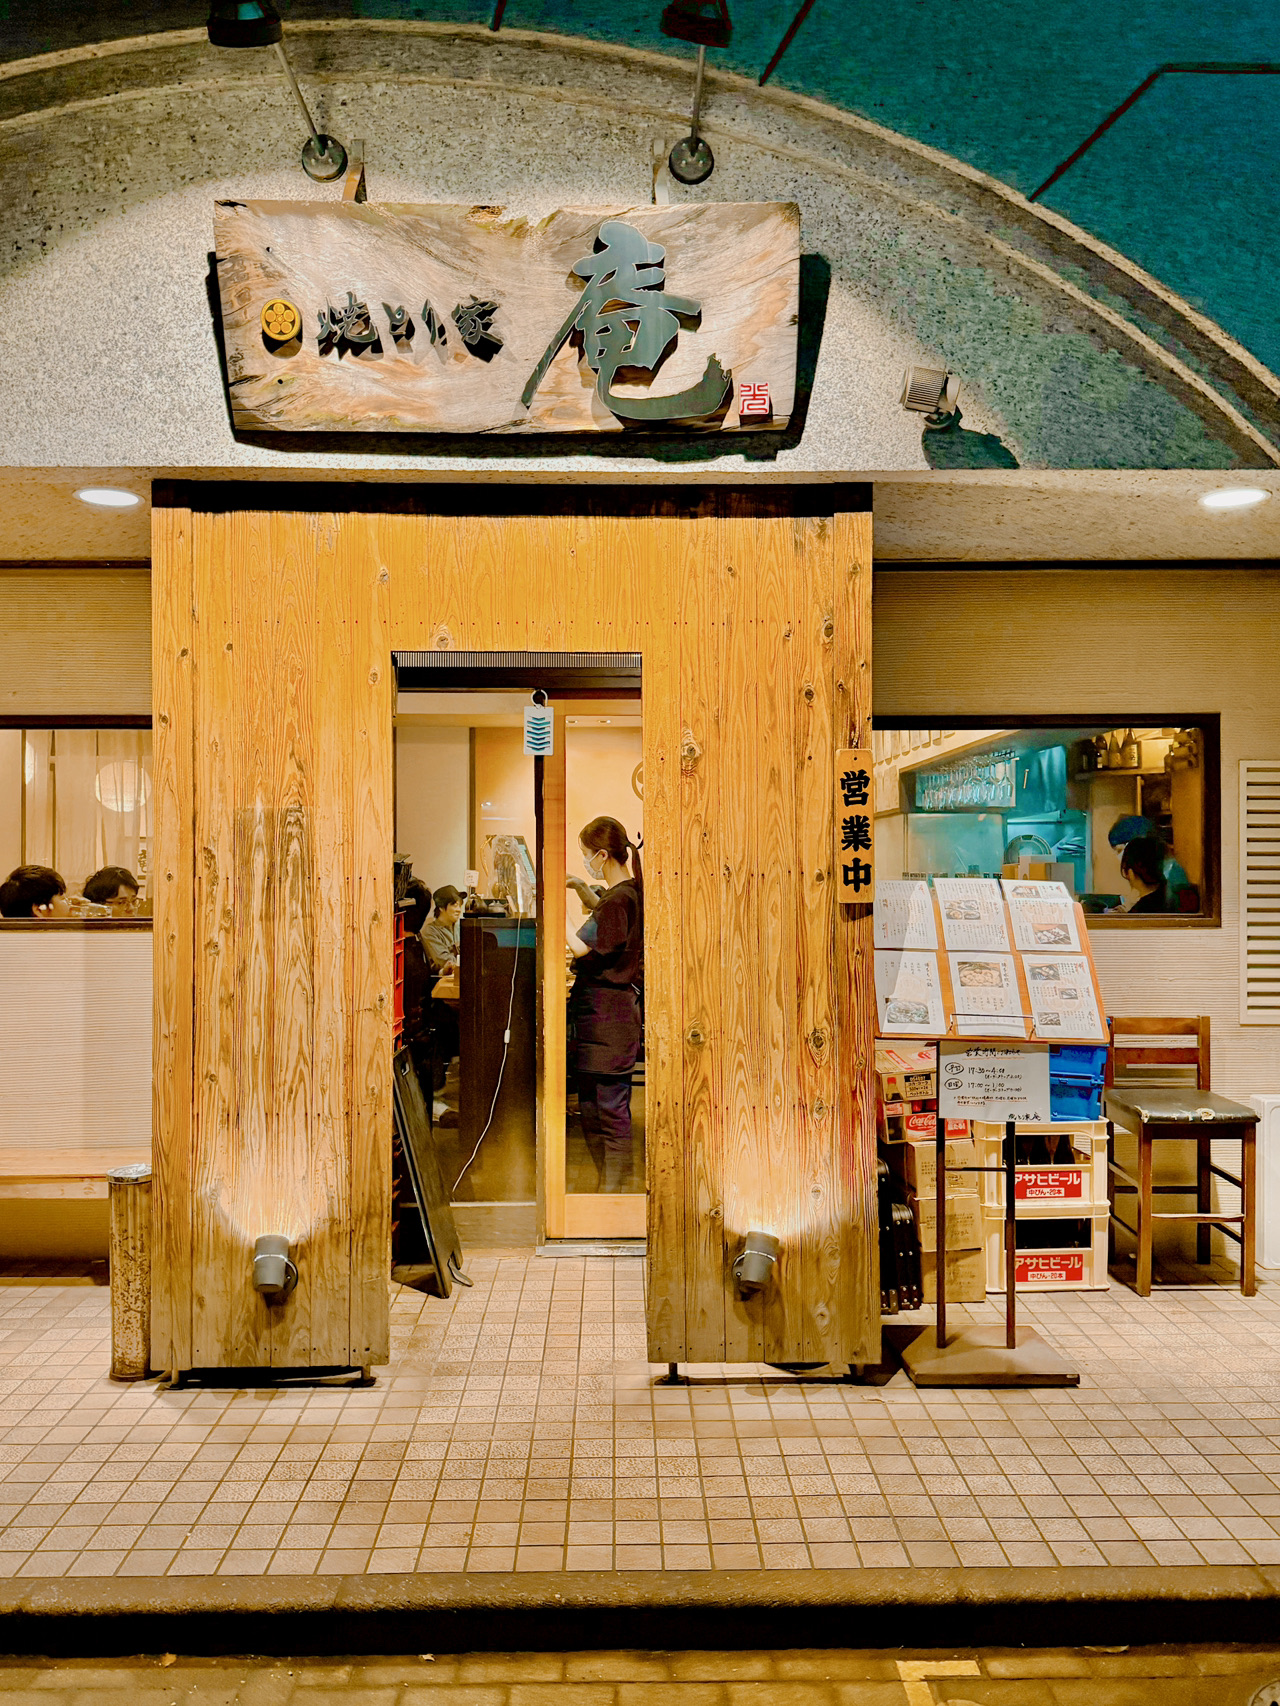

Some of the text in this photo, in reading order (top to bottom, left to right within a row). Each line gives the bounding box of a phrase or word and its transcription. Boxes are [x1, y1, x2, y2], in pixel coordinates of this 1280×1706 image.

[520, 220, 734, 420] 庵
[839, 768, 873, 893] 営業中
[908, 1114, 937, 1128] Coca-Col
[1015, 1172, 1081, 1186] アサヒビール
[1015, 1256, 1082, 1270] アサヒビール
